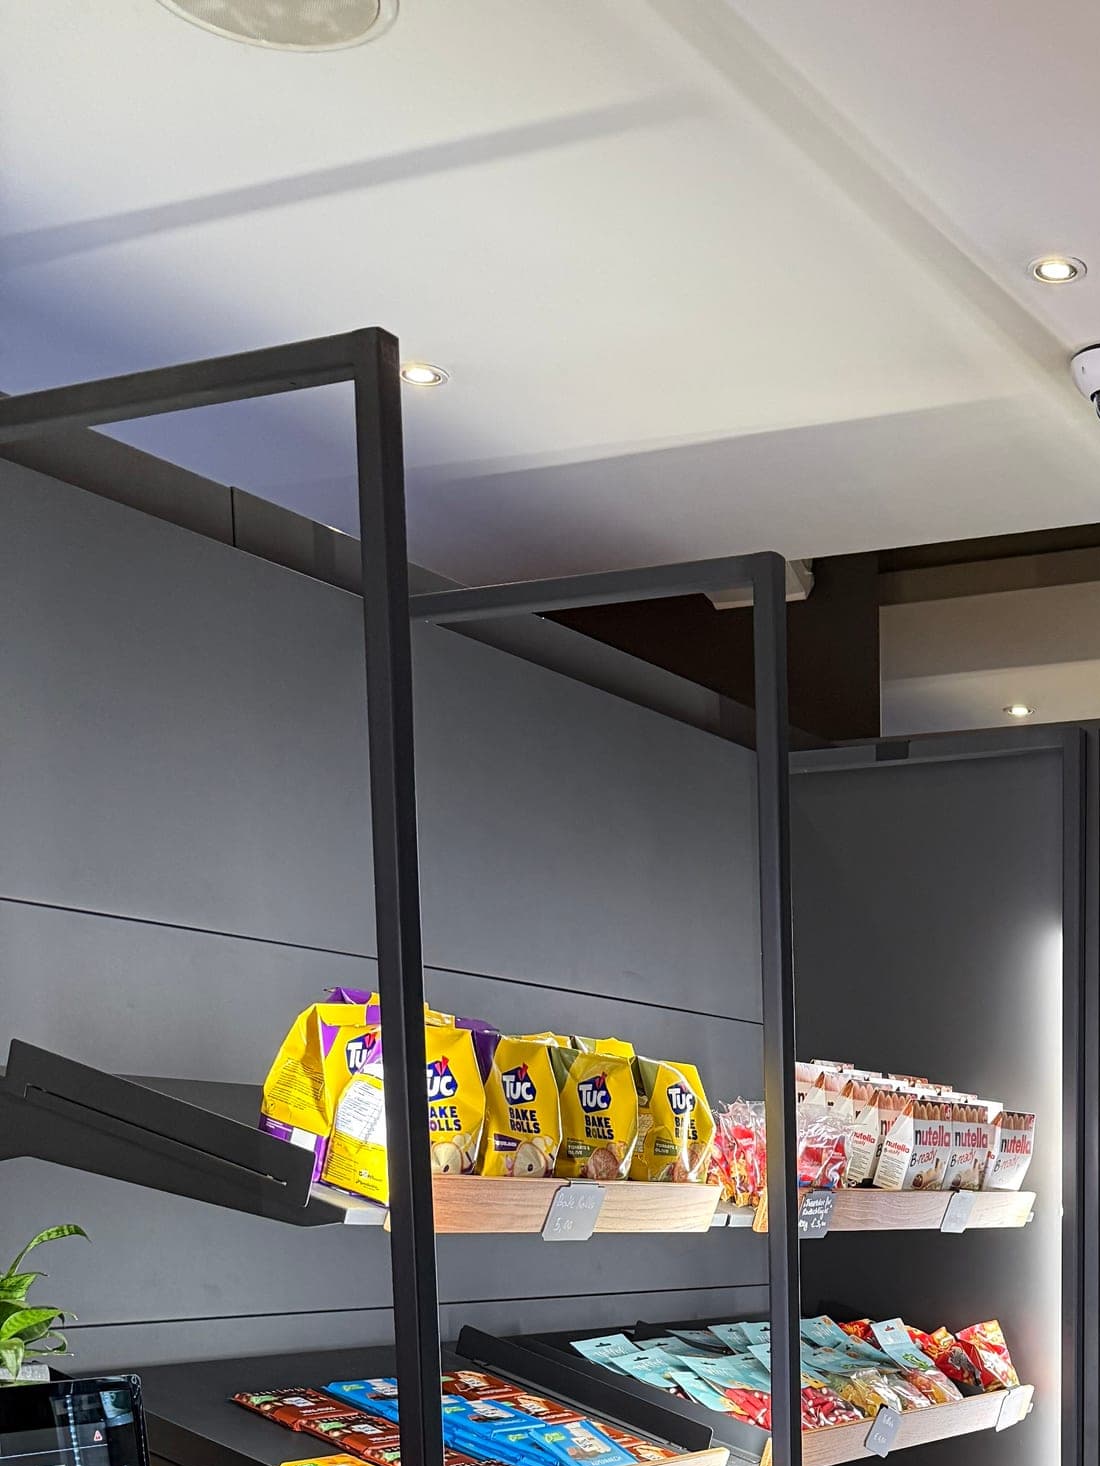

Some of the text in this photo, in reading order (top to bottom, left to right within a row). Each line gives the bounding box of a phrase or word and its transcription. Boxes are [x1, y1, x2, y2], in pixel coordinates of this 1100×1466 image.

[346, 1041, 371, 1069] TU
[502, 1074, 534, 1101] TUC
[579, 1084, 608, 1109] TUC
[430, 1105, 458, 1119] AKE
[509, 1107, 537, 1122] BAKE
[430, 1118, 462, 1131] OLLS
[510, 1119, 541, 1134] ROLLS
[585, 1115, 611, 1129] BAKE
[585, 1126, 614, 1140] ROLLS
[915, 1125, 951, 1148] nutella
[954, 1127, 989, 1149] nutella
[885, 1139, 910, 1154] nutella
[1000, 1135, 1031, 1155] nutella
[909, 1149, 938, 1168] B-ready
[950, 1150, 976, 1168] B-ready
